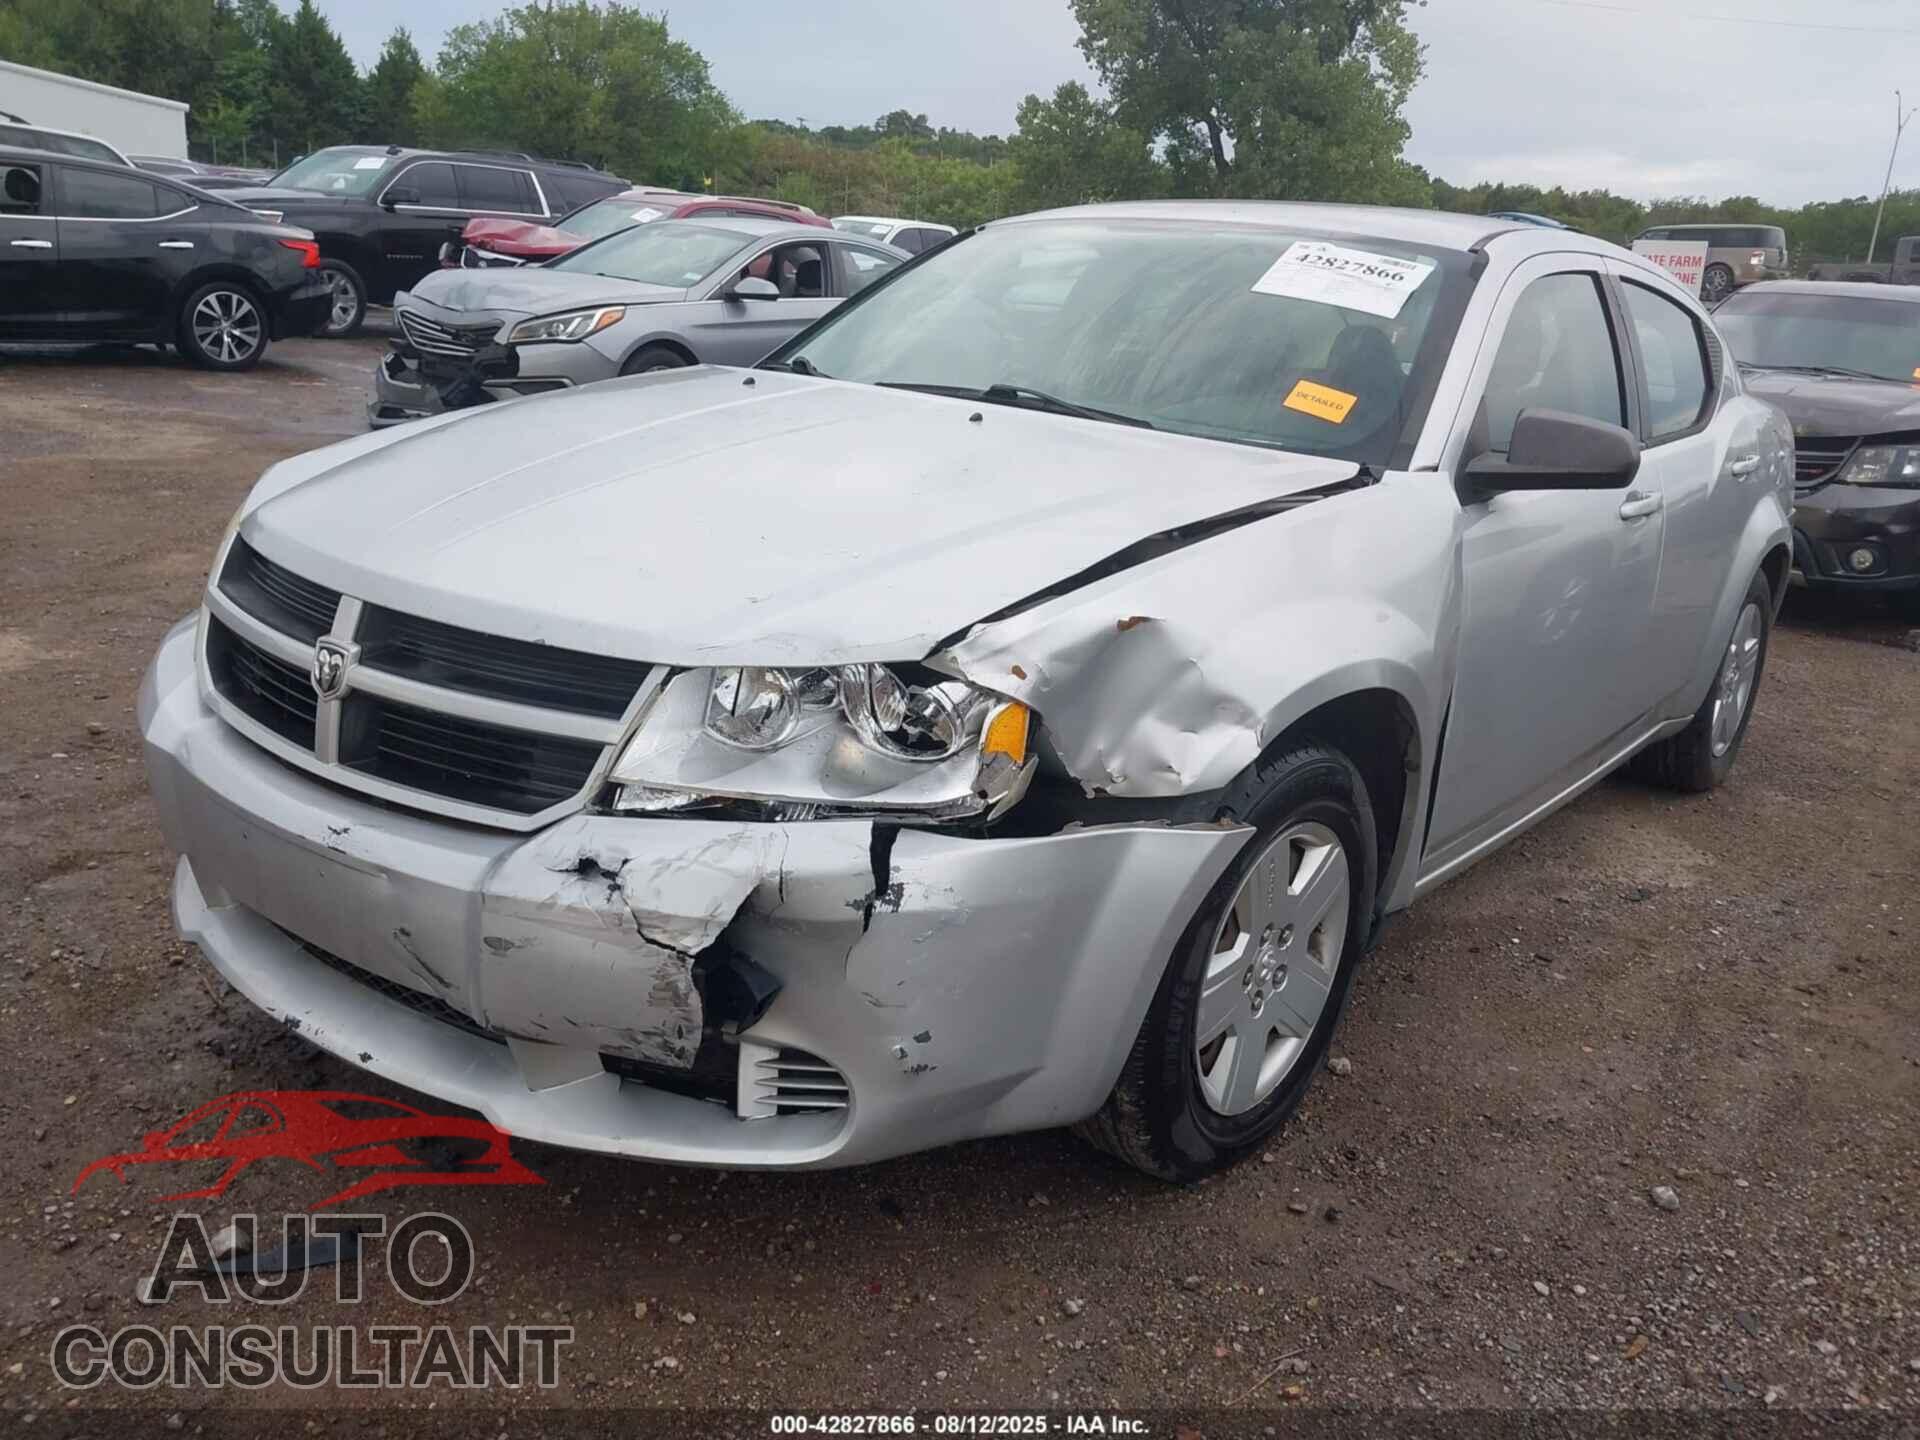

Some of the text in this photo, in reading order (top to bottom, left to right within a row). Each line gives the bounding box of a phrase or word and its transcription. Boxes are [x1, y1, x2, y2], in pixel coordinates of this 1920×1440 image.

[1296, 253, 1405, 281] 42827866
[1669, 255, 1702, 267] FARM
[1671, 271, 1697, 285] ONE
